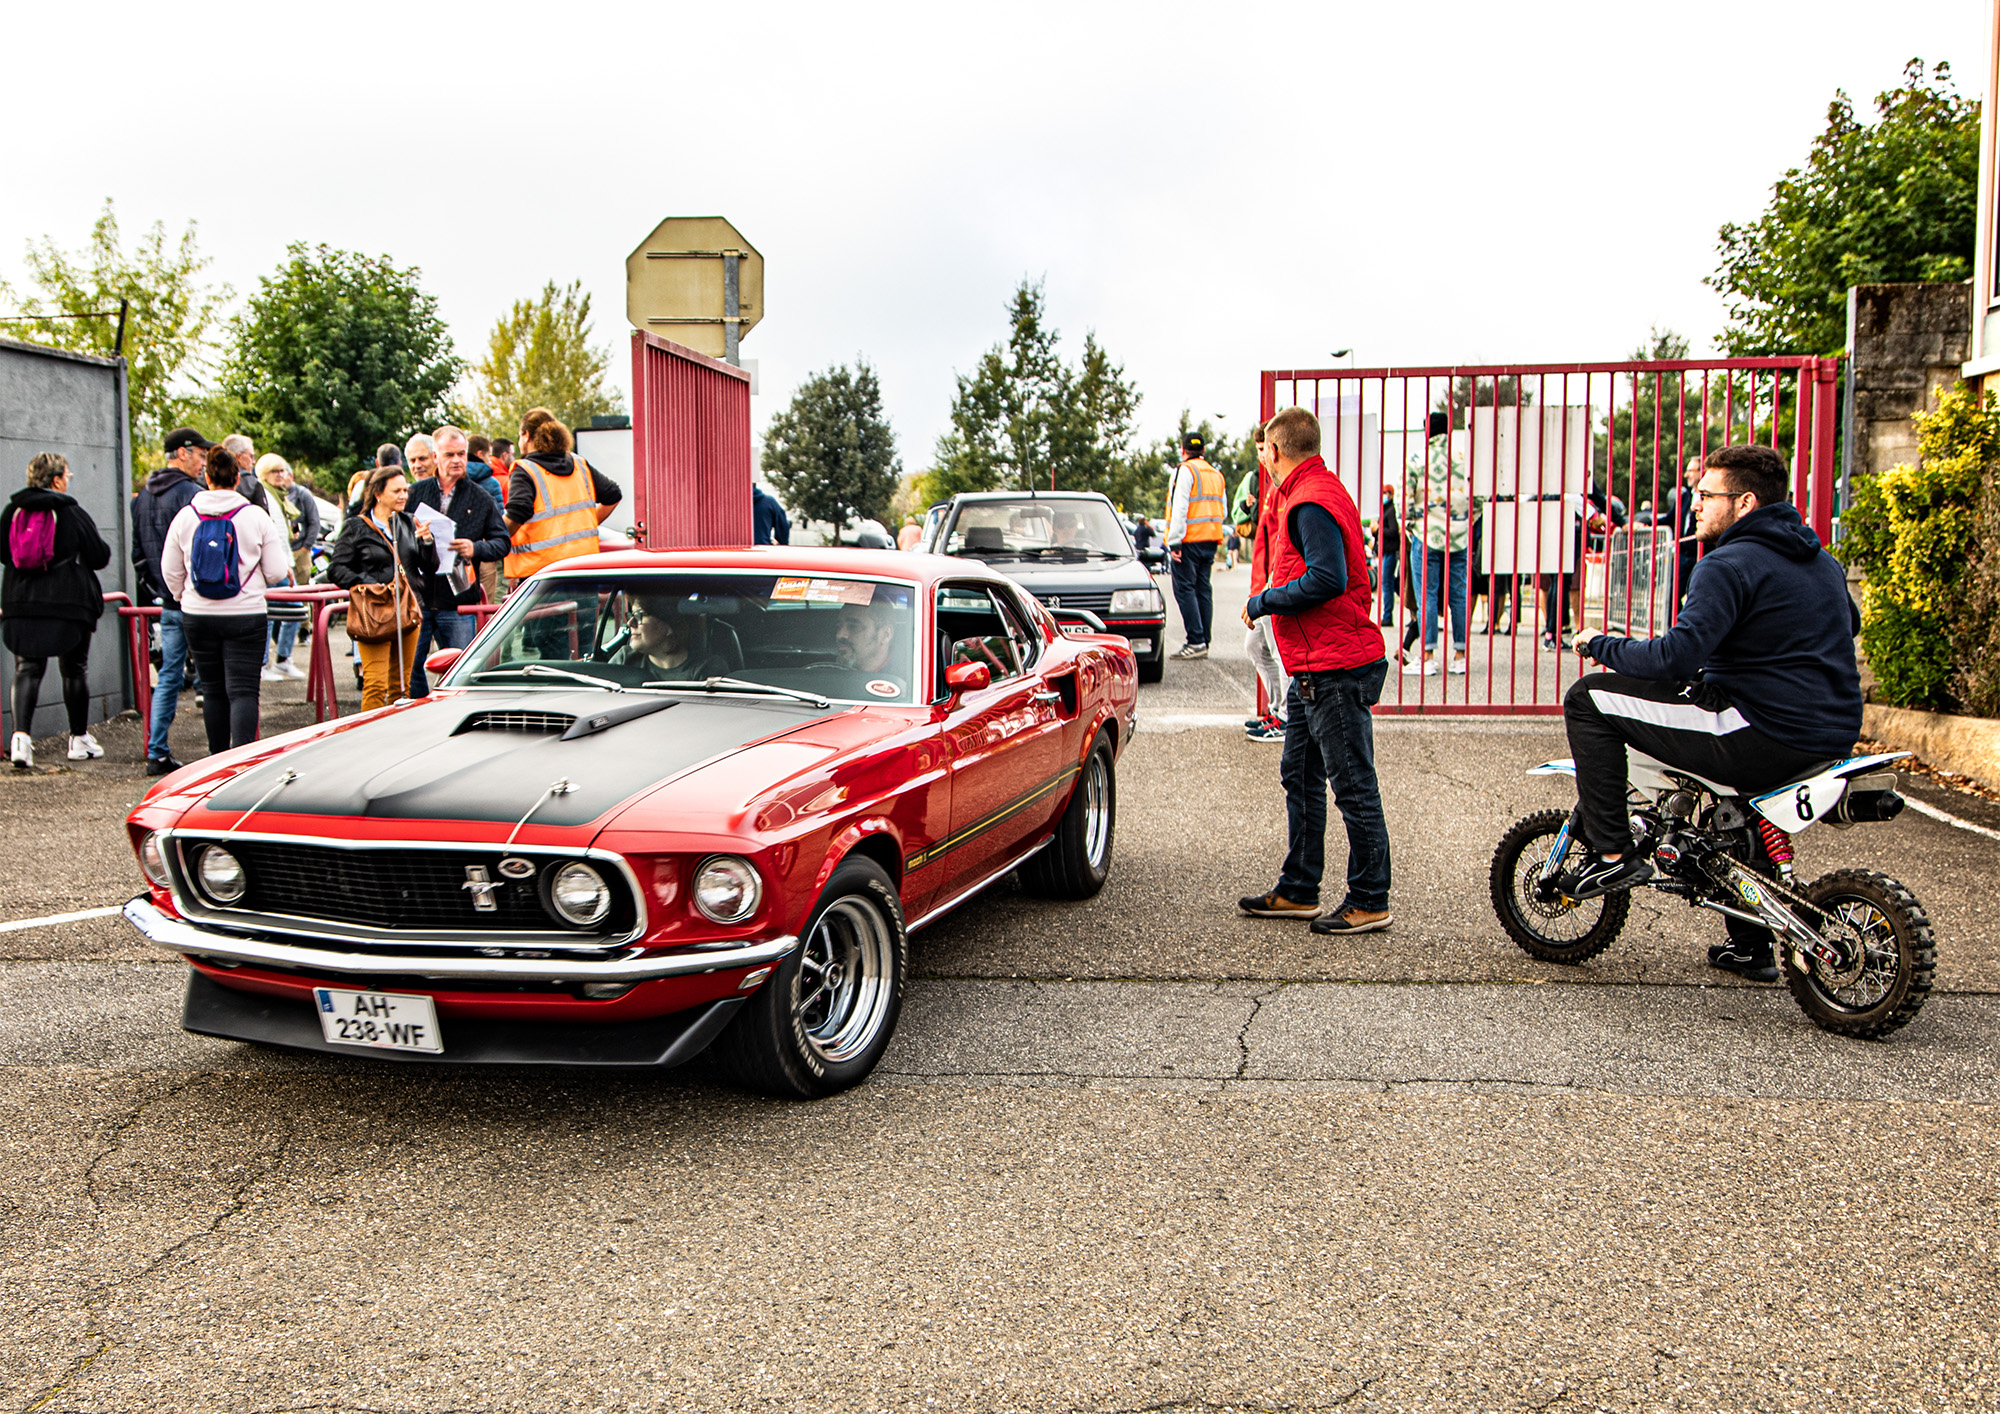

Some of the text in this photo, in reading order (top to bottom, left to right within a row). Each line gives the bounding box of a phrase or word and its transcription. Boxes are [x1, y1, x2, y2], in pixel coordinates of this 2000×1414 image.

[1796, 785, 1814, 821] 8
[355, 995, 396, 1018] AH-
[336, 1018, 424, 1046] 238-WF
